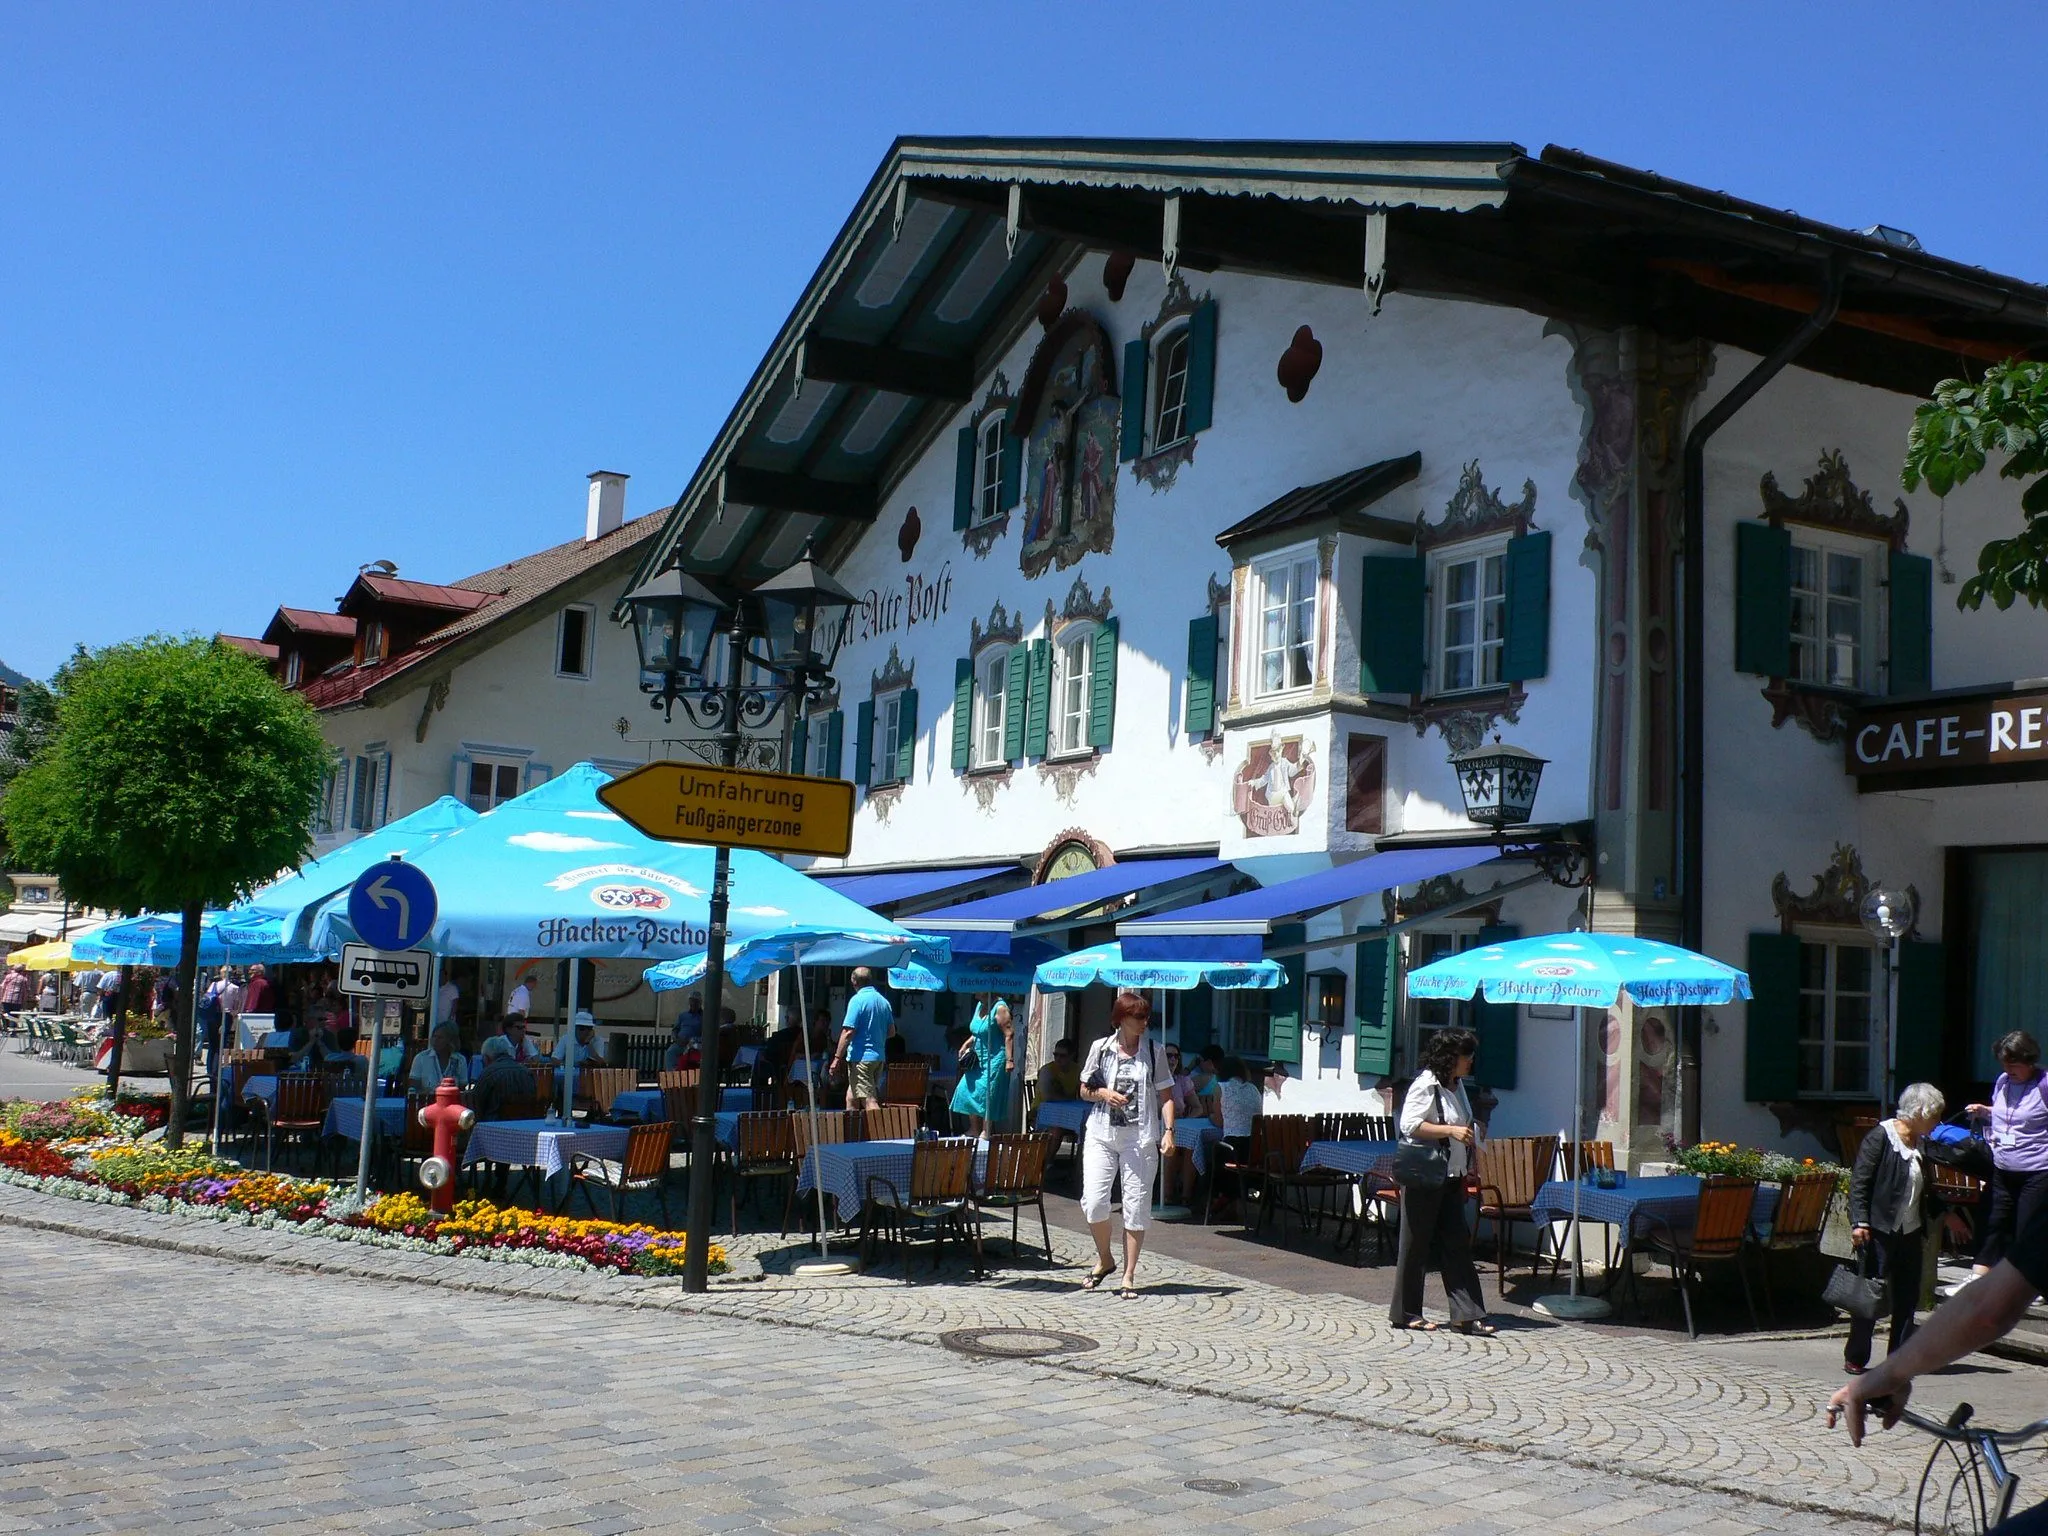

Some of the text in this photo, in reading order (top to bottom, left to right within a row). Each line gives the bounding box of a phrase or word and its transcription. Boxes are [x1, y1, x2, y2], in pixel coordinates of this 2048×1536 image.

[1855, 706, 2048, 764] CAFE-RE
[680, 775, 804, 812] Umfahrung
[676, 804, 802, 836] Fußgängerzone
[537, 917, 709, 951] Hacker-Pscho
[1113, 971, 1189, 985] Hacker-Pschorr
[1498, 981, 1602, 999] Hacker-Pschorr
[1636, 981, 1720, 1001] Hacker-Pschorr
